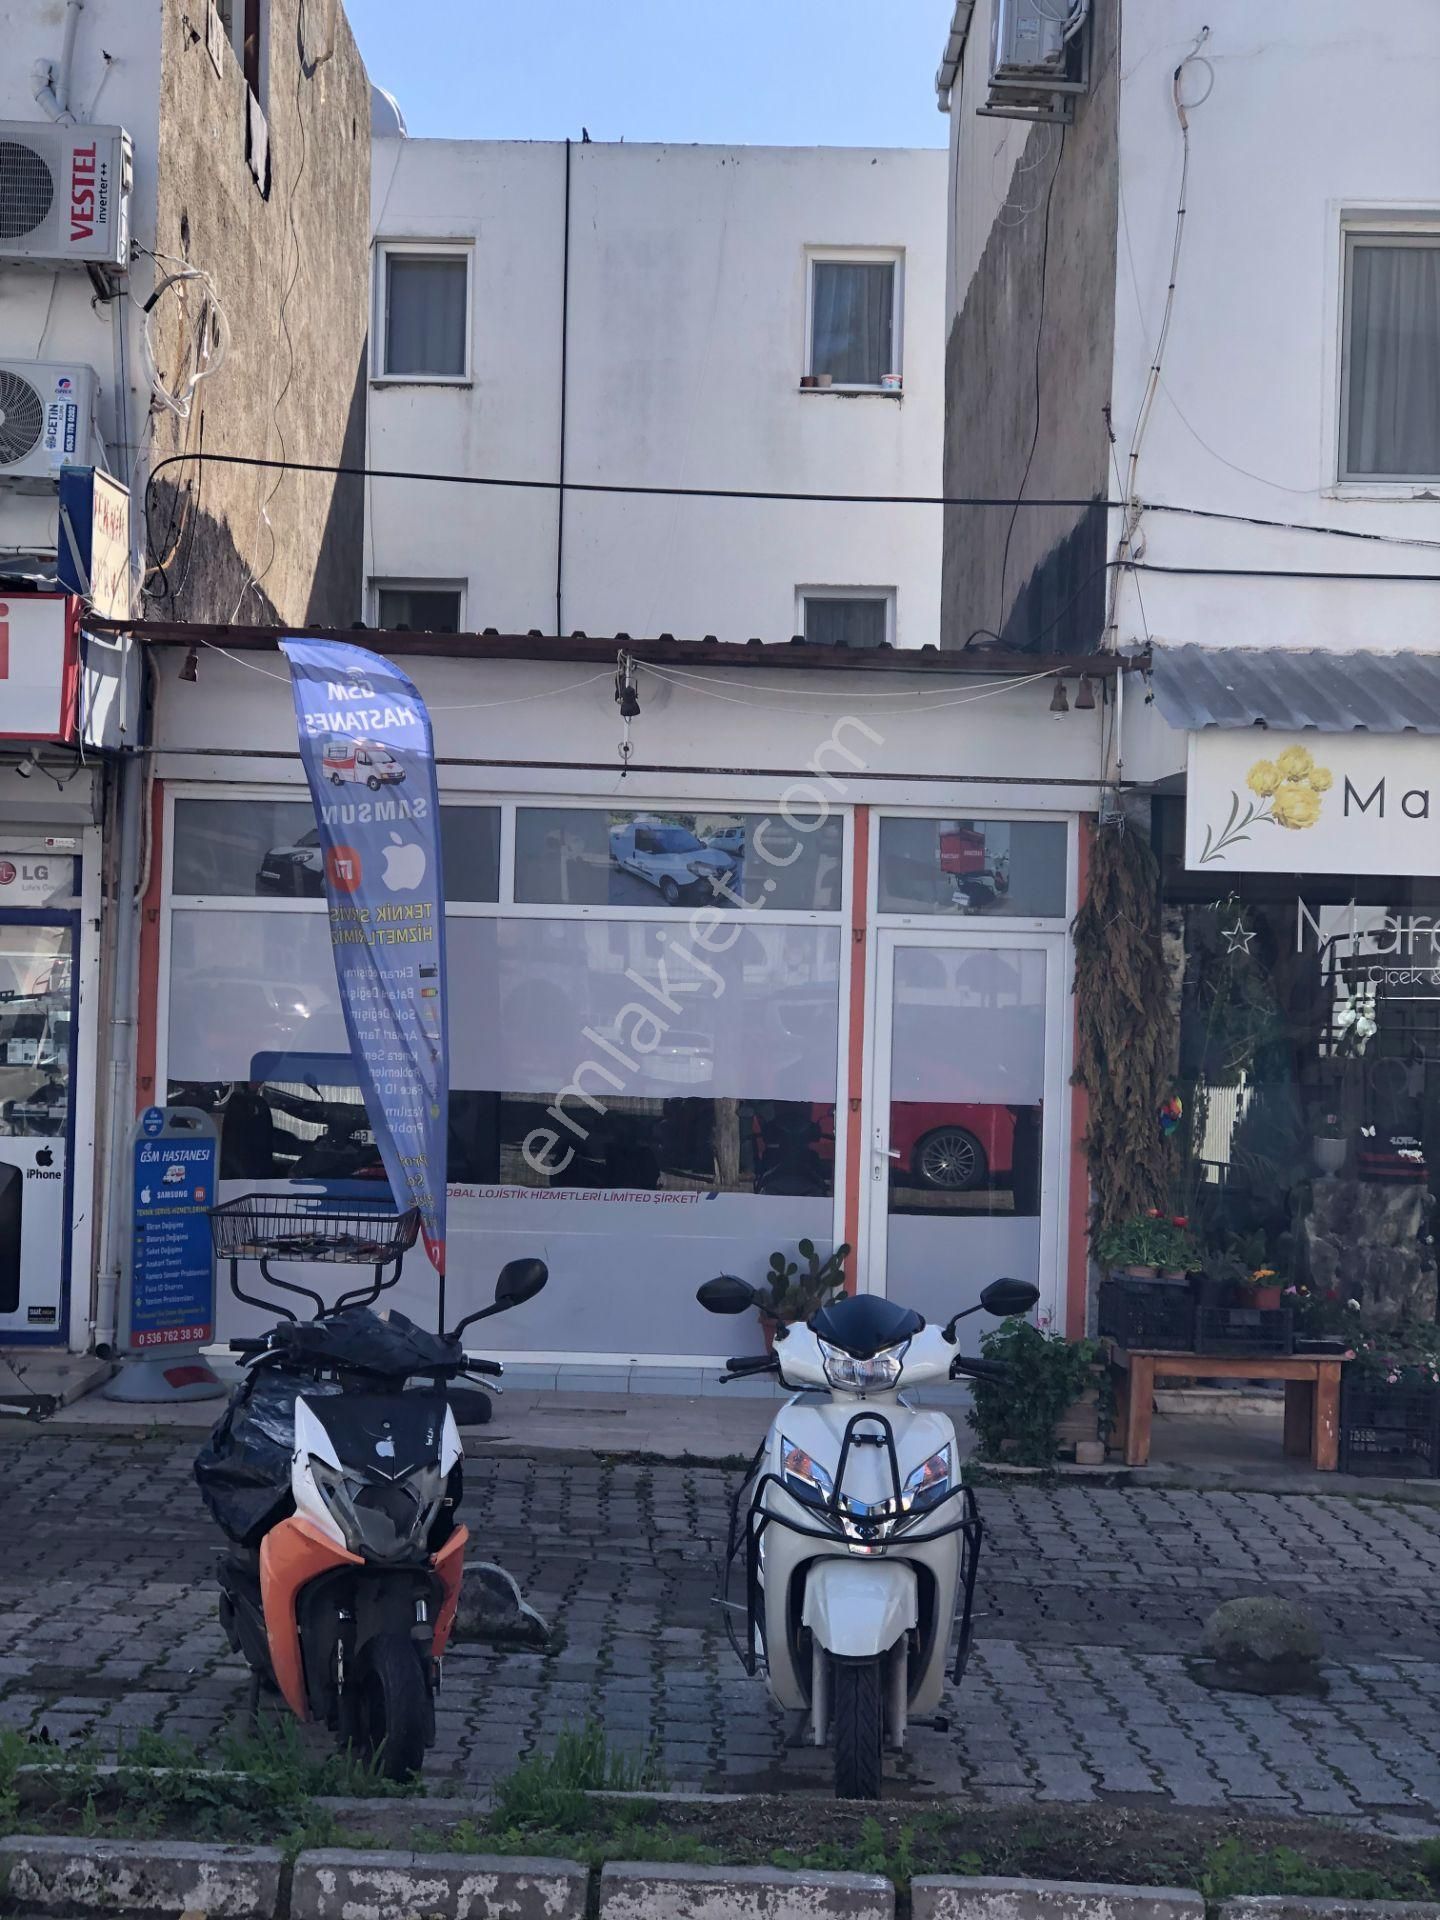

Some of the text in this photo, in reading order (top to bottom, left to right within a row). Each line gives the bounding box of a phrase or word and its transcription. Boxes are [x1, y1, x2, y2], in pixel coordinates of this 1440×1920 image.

[70, 142, 97, 242] VESTEL
[96, 162, 108, 224] inverter++
[22, 865, 49, 881] LG
[140, 1151, 160, 1163] GSM
[26, 1168, 62, 1180] iPhone
[156, 1190, 188, 1200] SAMSUNG
[478, 1187, 529, 1200] LOJİSTİK
[530, 1188, 602, 1202] HİZMETLERİ
[603, 1191, 652, 1203] LİMİTED
[653, 1190, 700, 1205] ŞİRKETİ
[138, 1327, 204, 1345] 0 536 762 38 50
